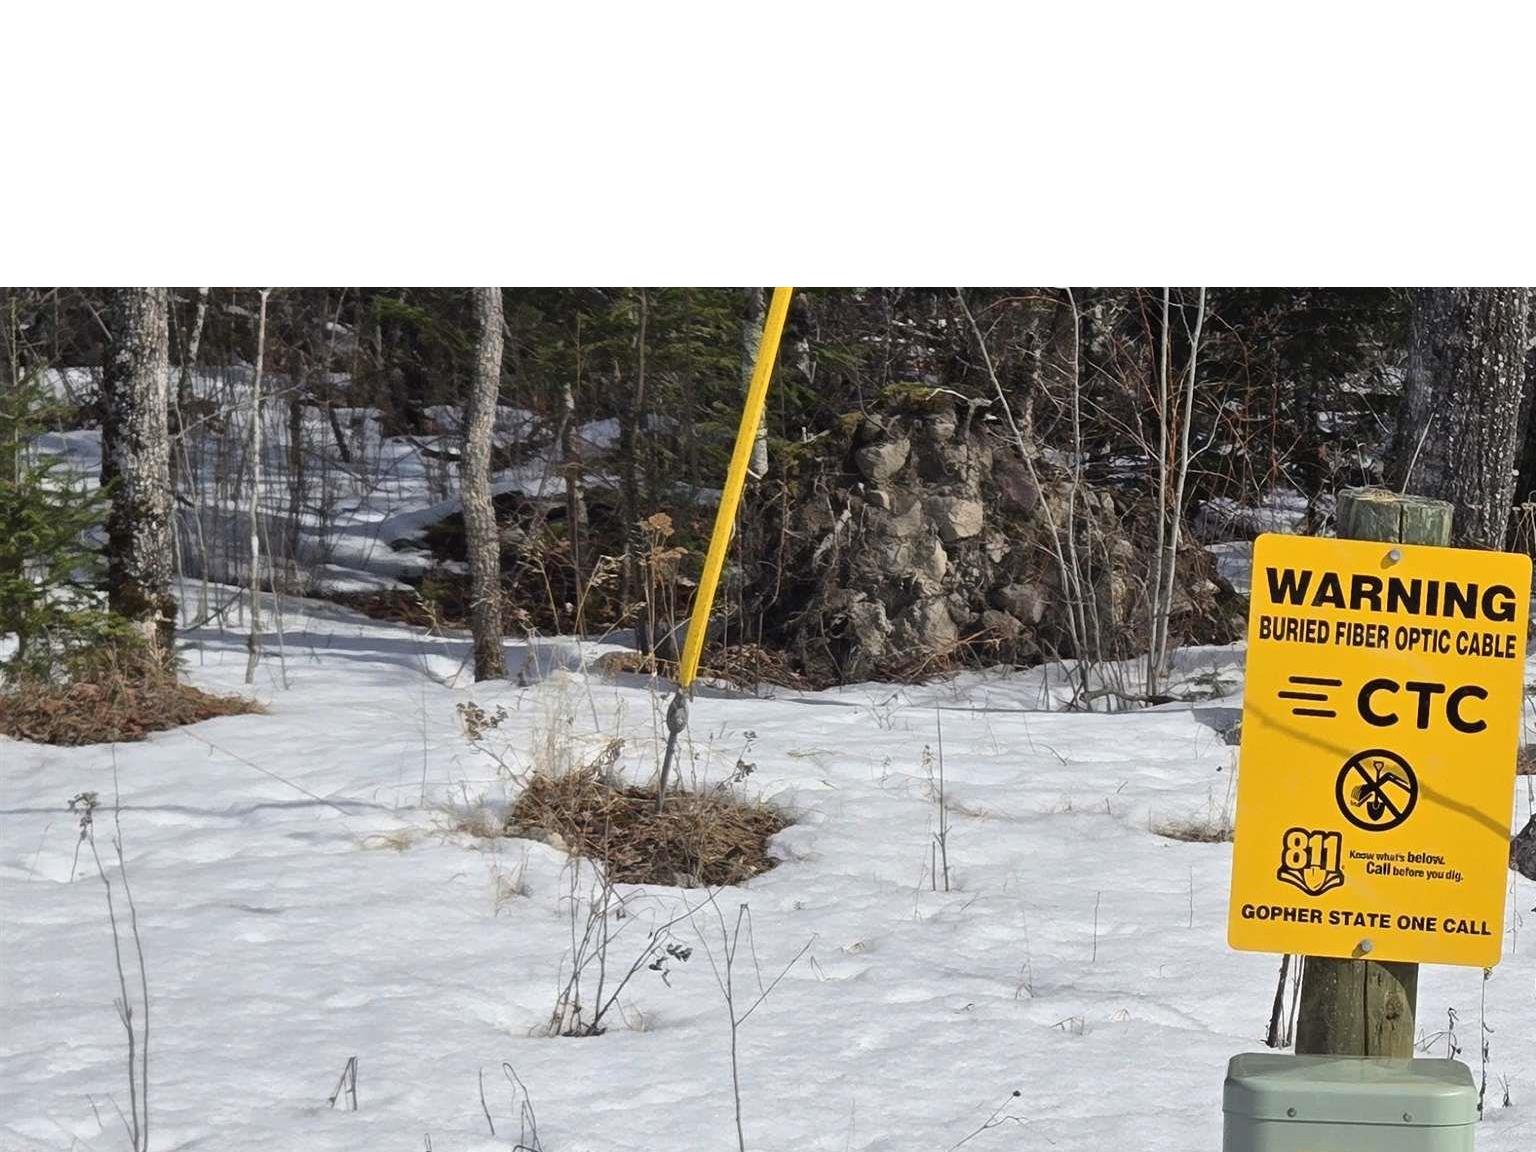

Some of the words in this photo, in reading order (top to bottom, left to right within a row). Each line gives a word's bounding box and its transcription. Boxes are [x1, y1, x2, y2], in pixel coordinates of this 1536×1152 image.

[1265, 566, 1517, 622] WARNING
[1259, 615, 1329, 644] BURIED
[1335, 621, 1388, 649] FIBER
[1395, 626, 1449, 654] OPTIC
[1456, 631, 1517, 659] CABLE
[1357, 678, 1489, 734] CTC
[1284, 830, 1340, 872] 811
[1349, 850, 1374, 860] Know
[1376, 852, 1405, 862] what's
[1408, 852, 1445, 865] below.
[1366, 861, 1391, 875] Call
[1393, 866, 1424, 877] before
[1426, 870, 1444, 880] you
[1446, 870, 1463, 882] dig.
[1241, 903, 1322, 924] GOPHER
[1328, 910, 1391, 929] STATE
[1397, 914, 1437, 932] ONE
[1443, 918, 1492, 936] CALL
